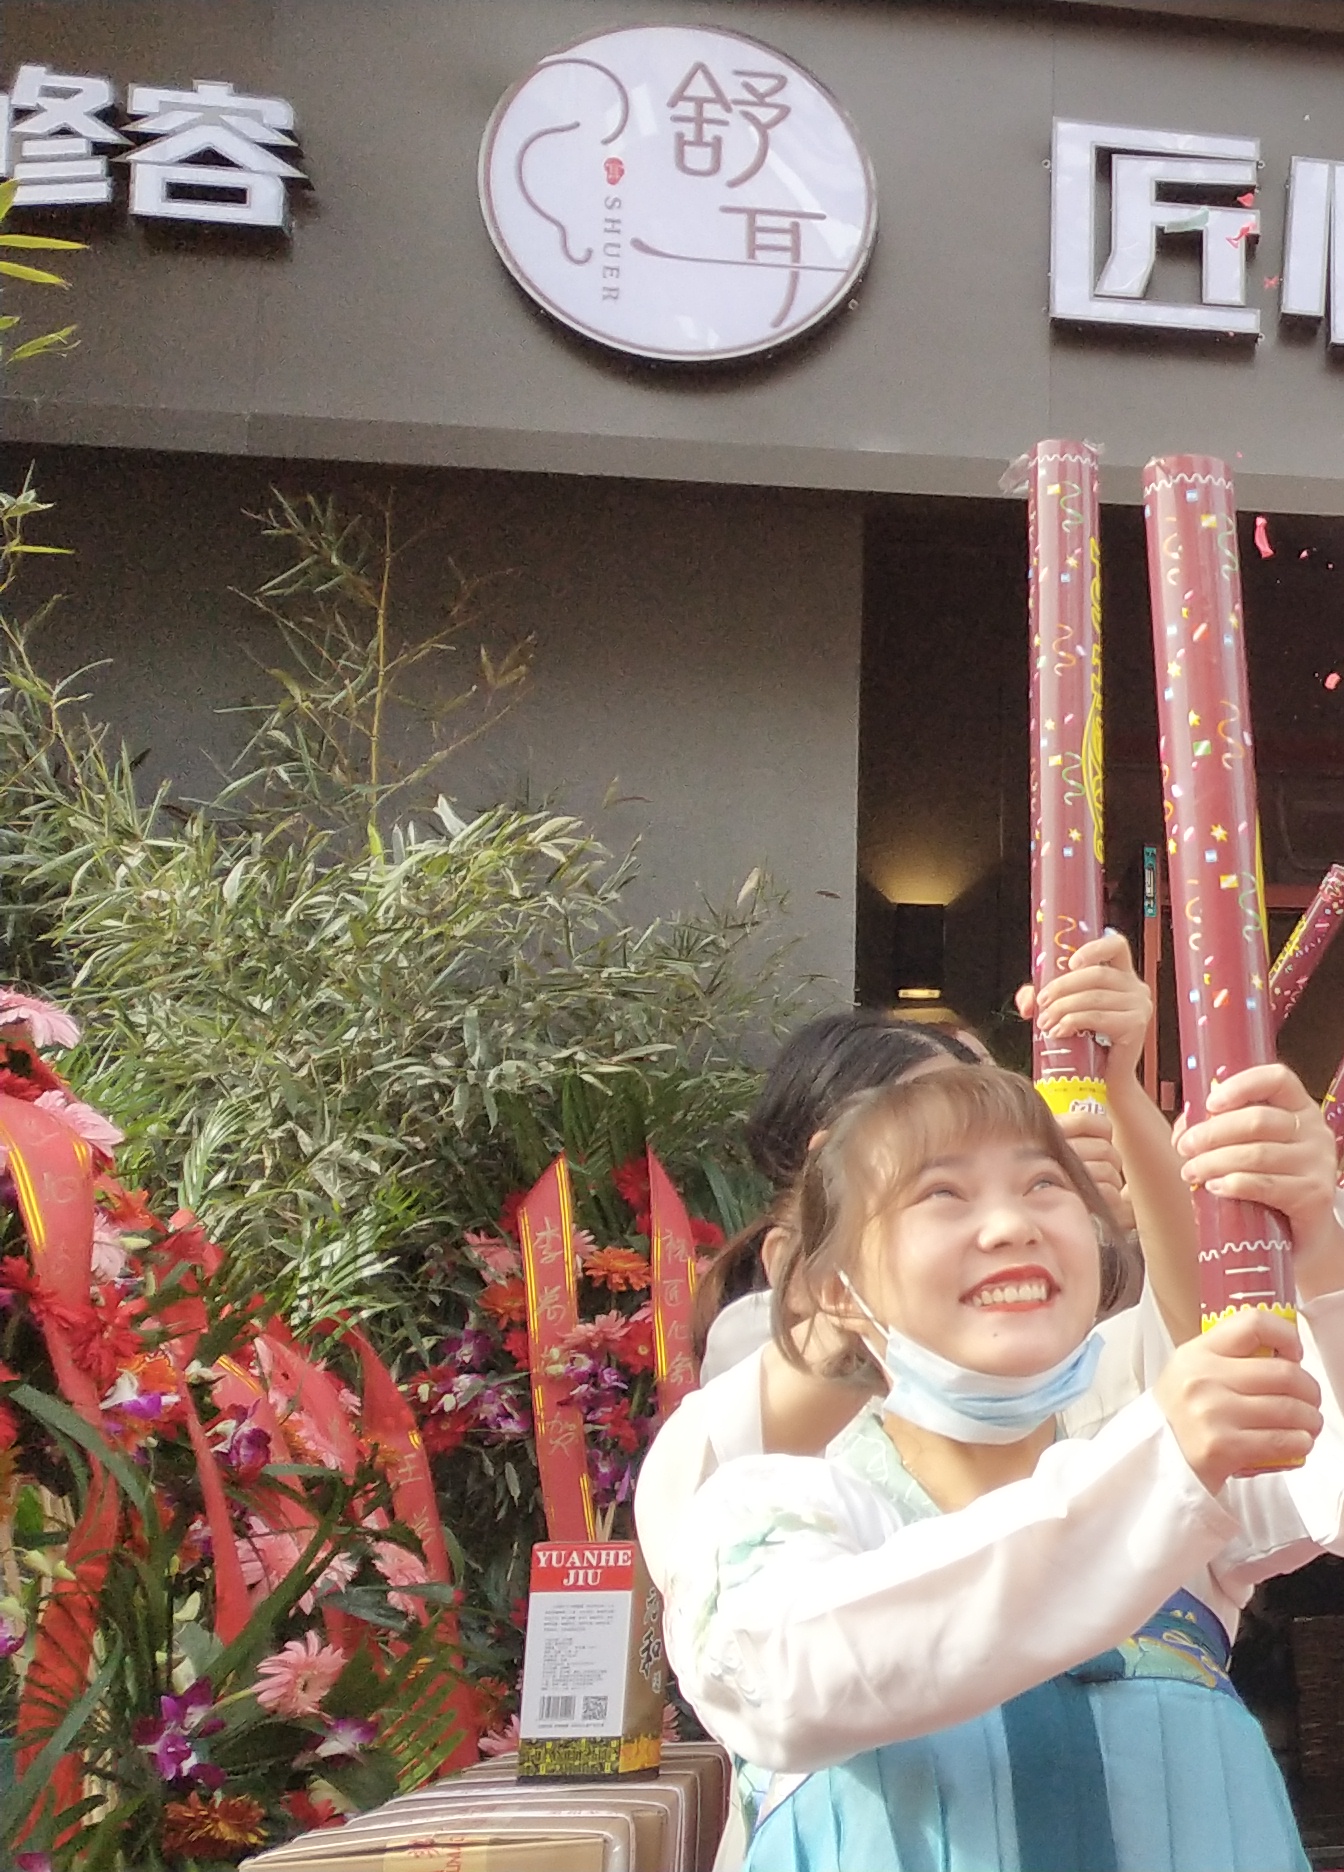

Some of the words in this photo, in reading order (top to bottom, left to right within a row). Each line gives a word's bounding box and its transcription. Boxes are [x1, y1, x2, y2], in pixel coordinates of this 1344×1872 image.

[602, 195, 622, 301] SHUER
[536, 1549, 632, 1568] YUANHE
[562, 1569, 603, 1587] JIU
